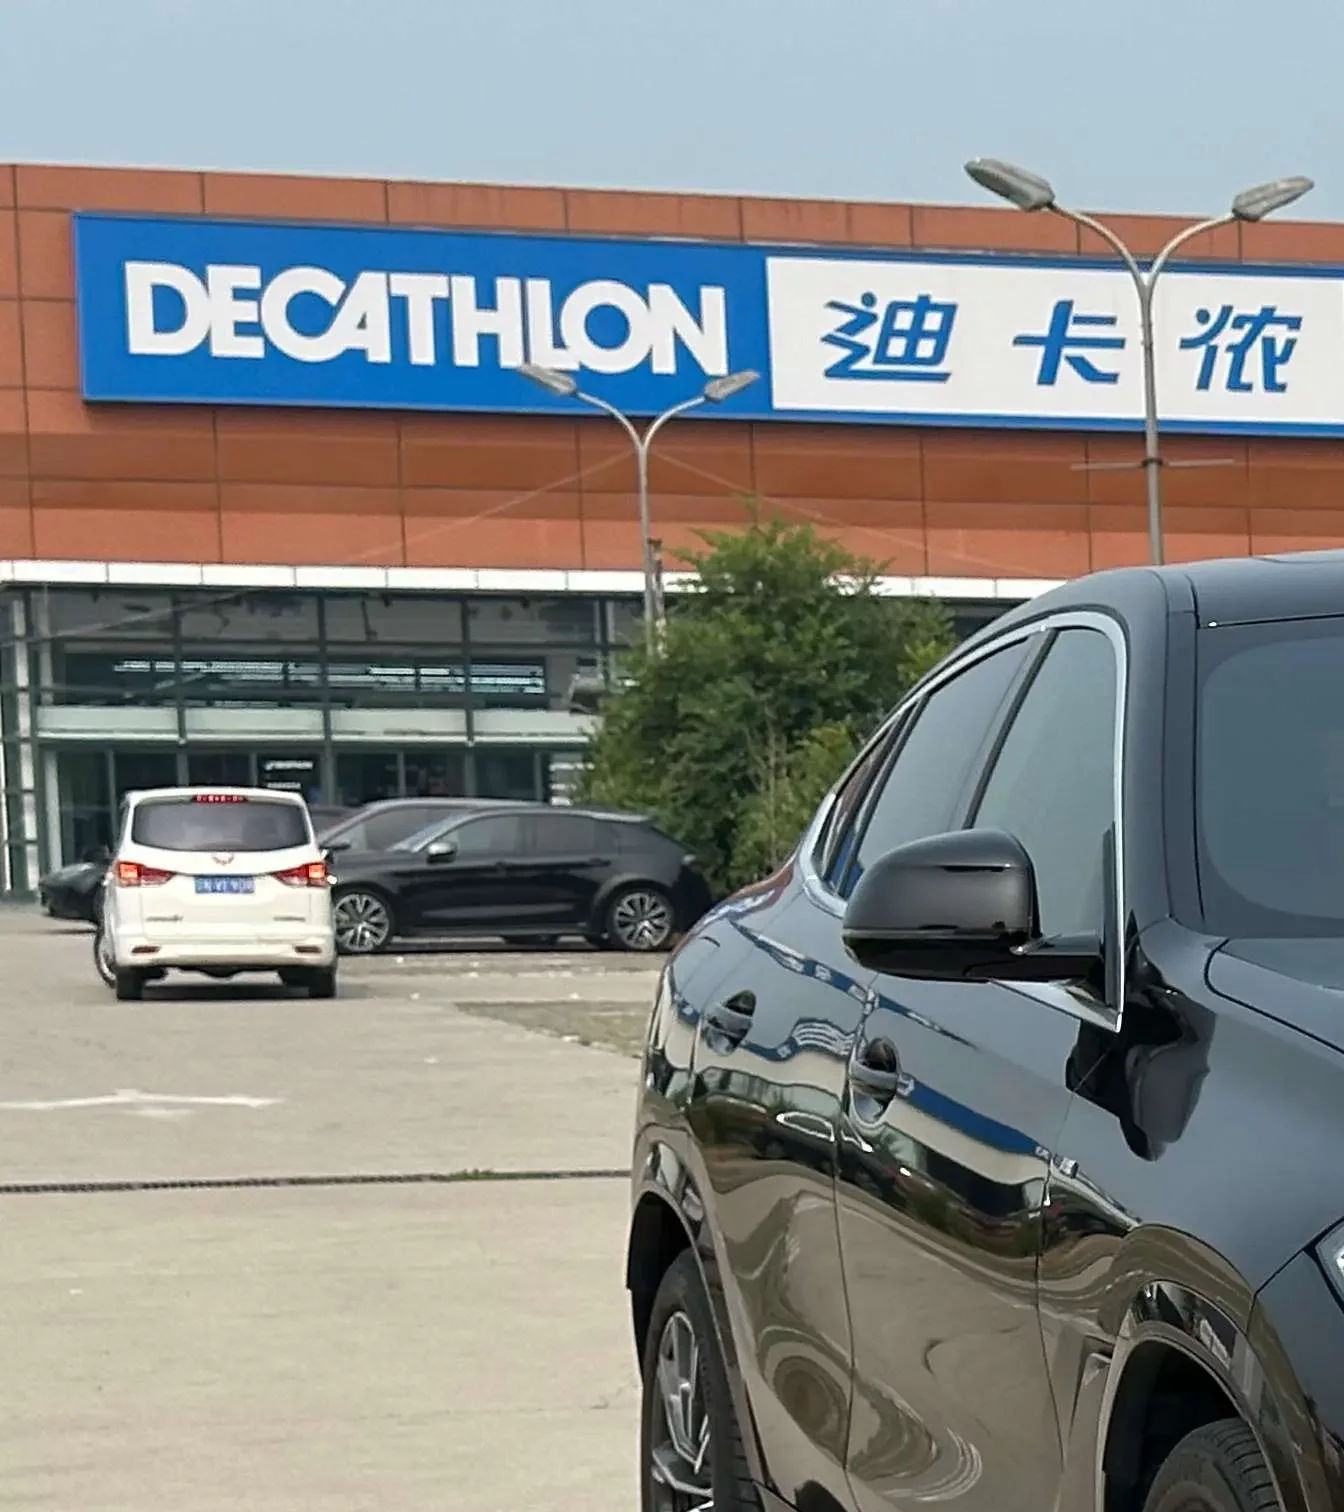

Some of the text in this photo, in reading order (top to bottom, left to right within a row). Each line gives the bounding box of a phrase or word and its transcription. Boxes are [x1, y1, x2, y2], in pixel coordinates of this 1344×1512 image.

[124, 260, 730, 377] DECATHLON
[822, 291, 1304, 393] 迪卡侬
